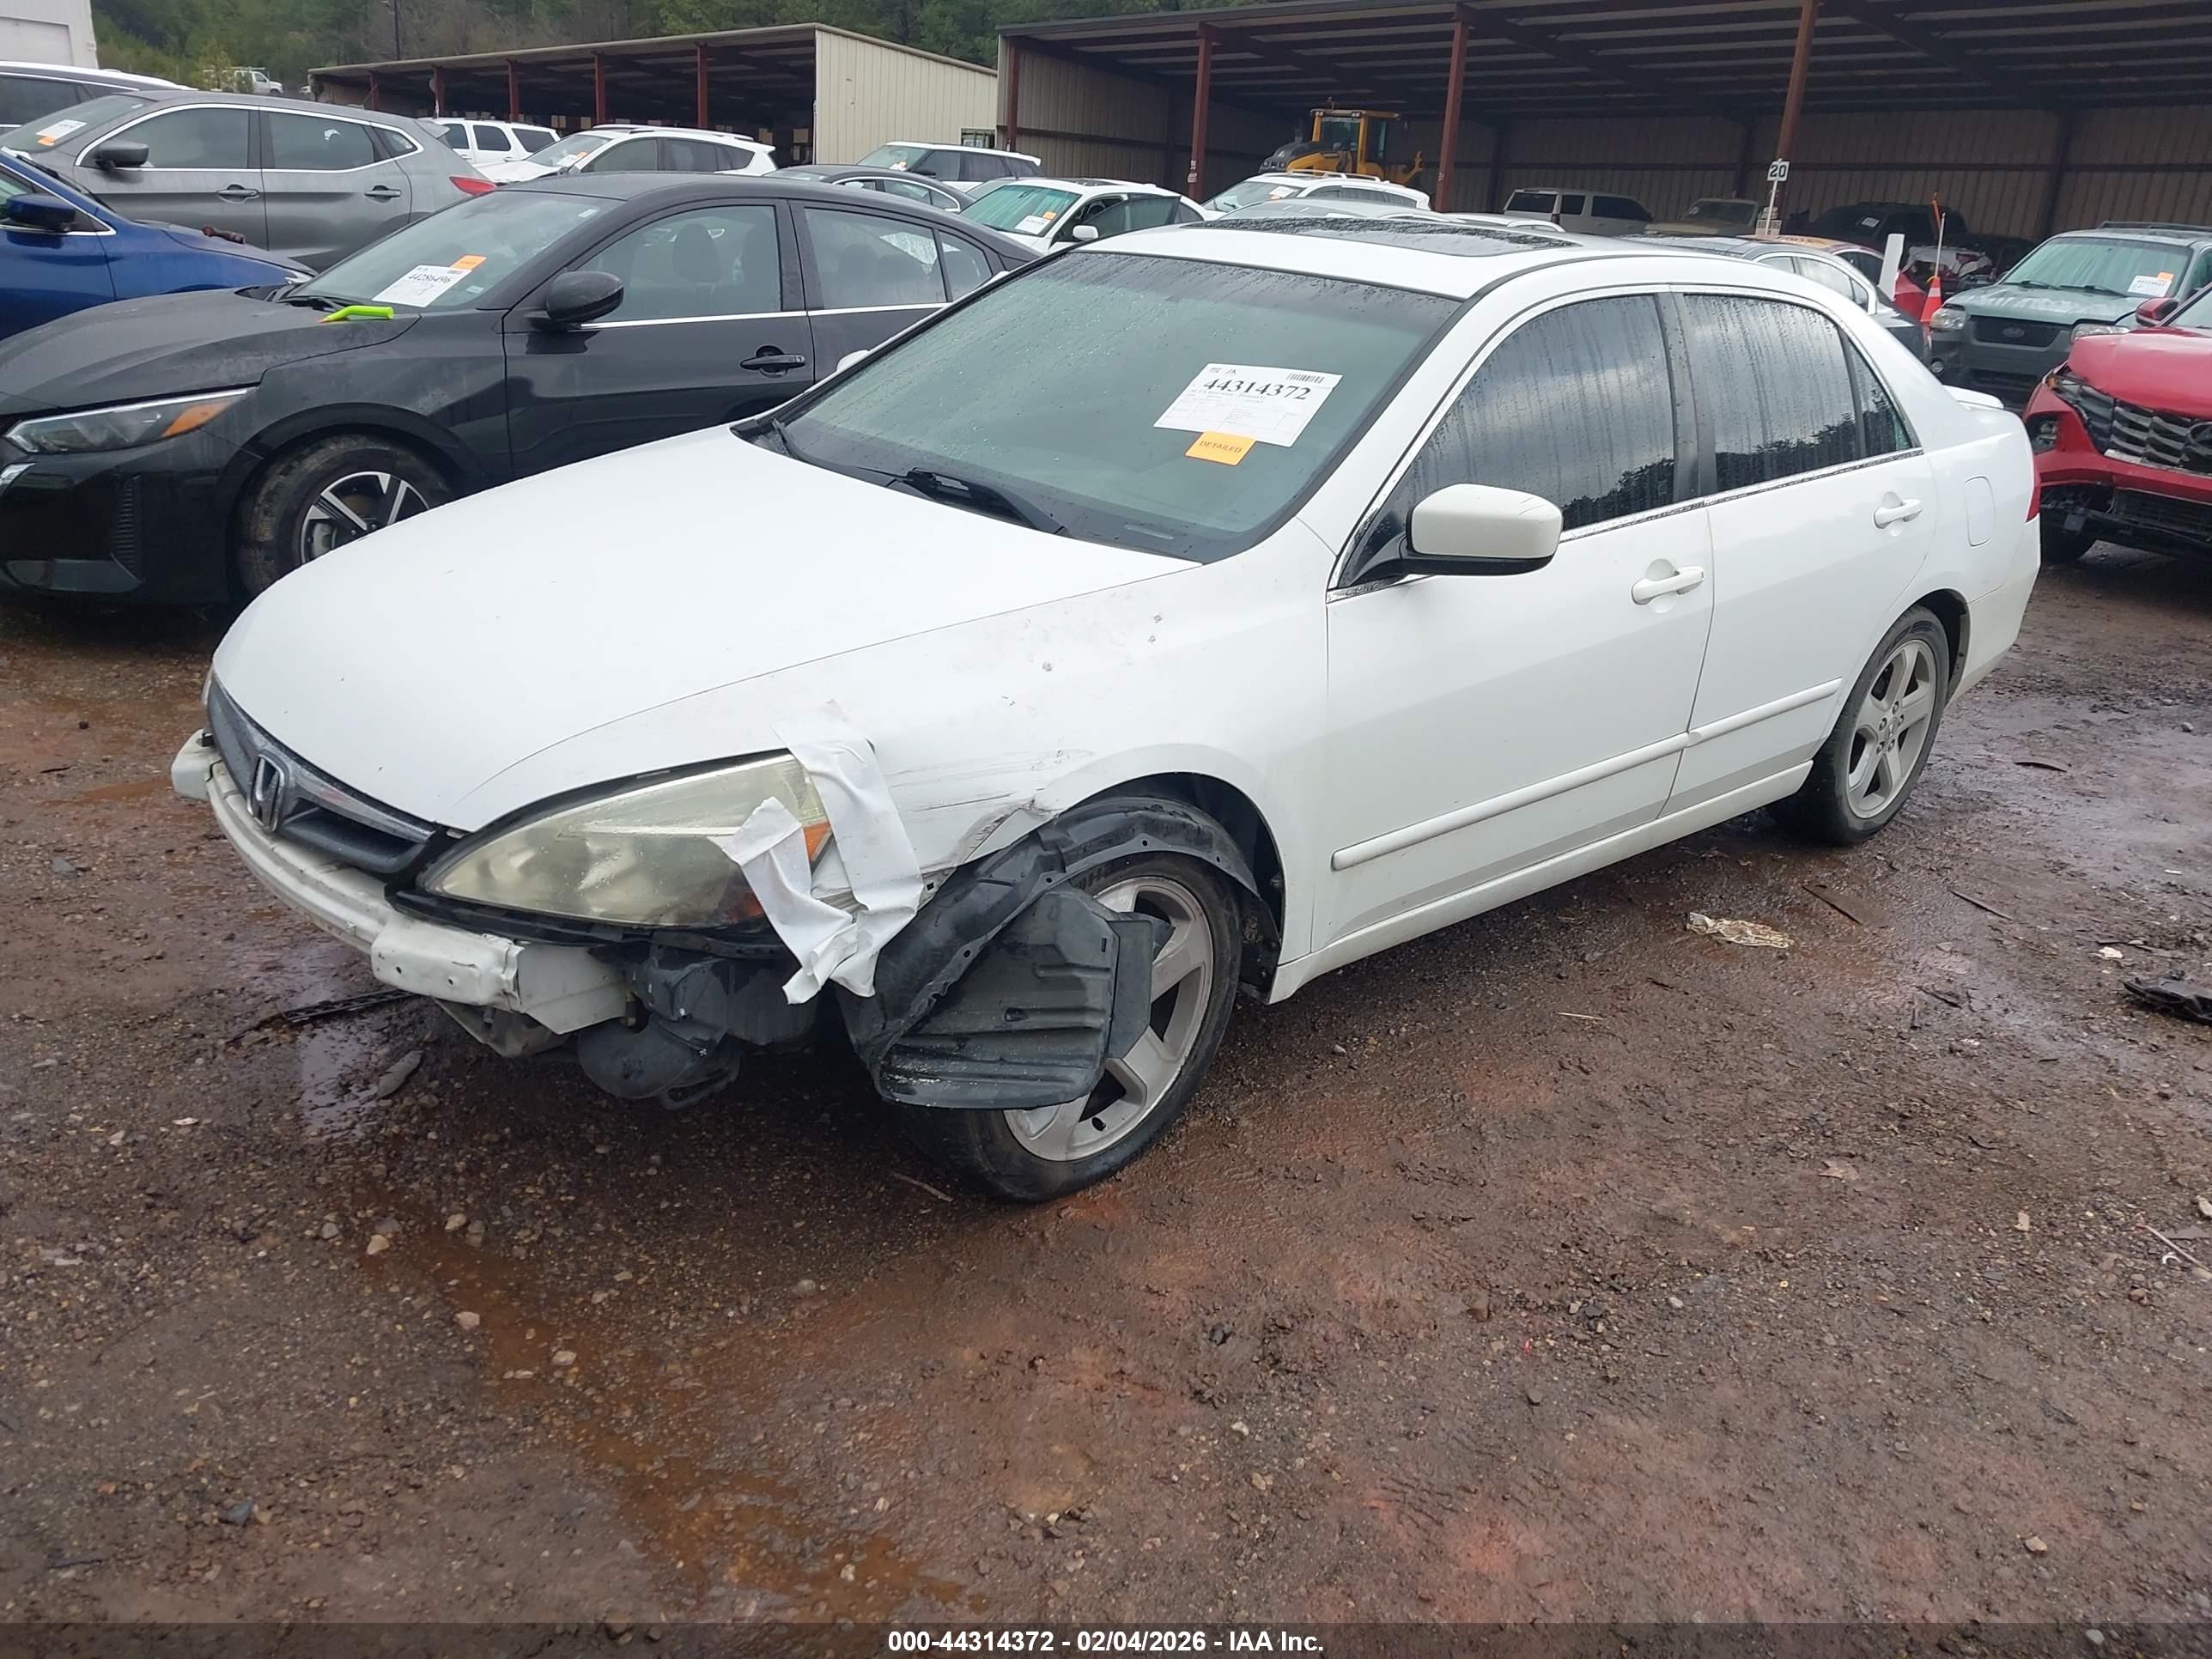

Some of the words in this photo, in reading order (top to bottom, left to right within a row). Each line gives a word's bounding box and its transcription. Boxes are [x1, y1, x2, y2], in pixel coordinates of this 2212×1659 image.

[1770, 164, 1787, 177] 20
[1203, 378, 1311, 400] 44314372
[1199, 440, 1243, 453] DETAILED
